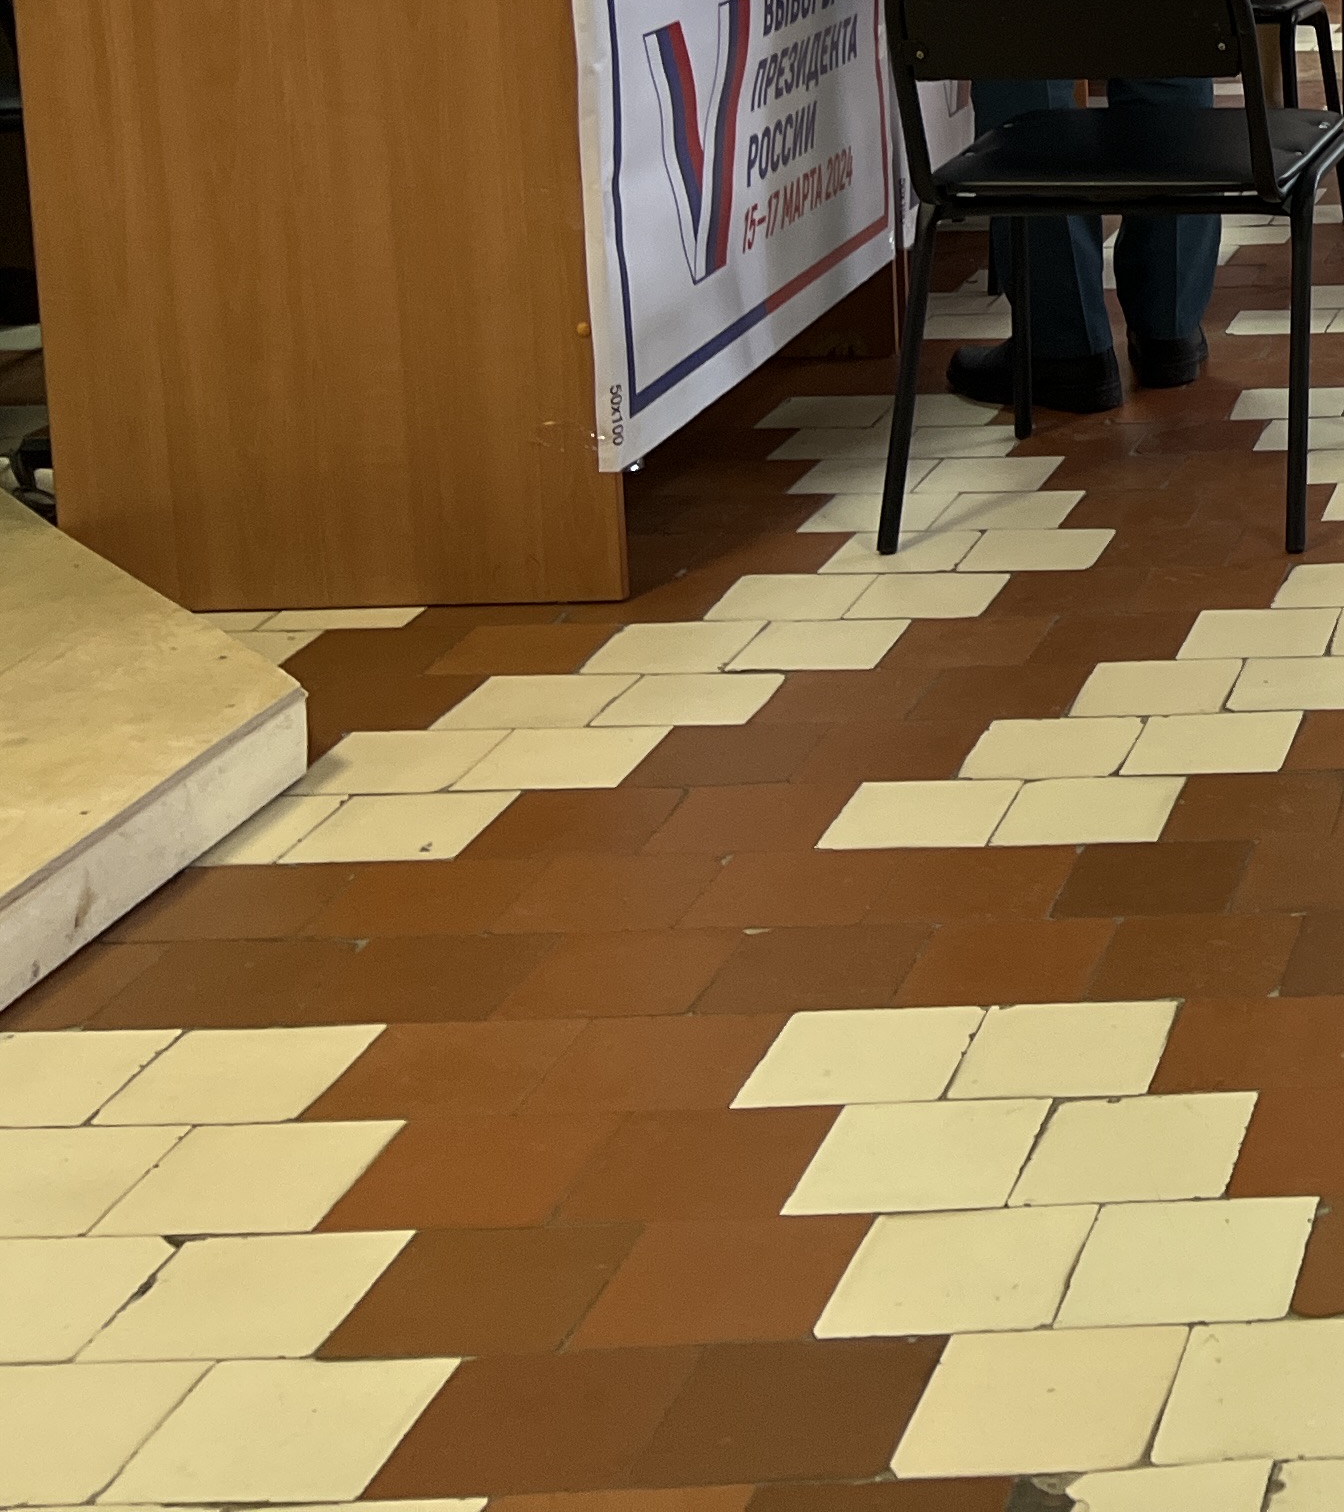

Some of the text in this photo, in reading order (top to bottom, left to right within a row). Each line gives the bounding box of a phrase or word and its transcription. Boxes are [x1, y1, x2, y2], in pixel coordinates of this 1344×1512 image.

[750, 13, 858, 112] ПРЕЗИДЕНТА
[746, 100, 817, 188] РОССИИ
[780, 163, 823, 230] МАРТА
[824, 145, 854, 201] 2024
